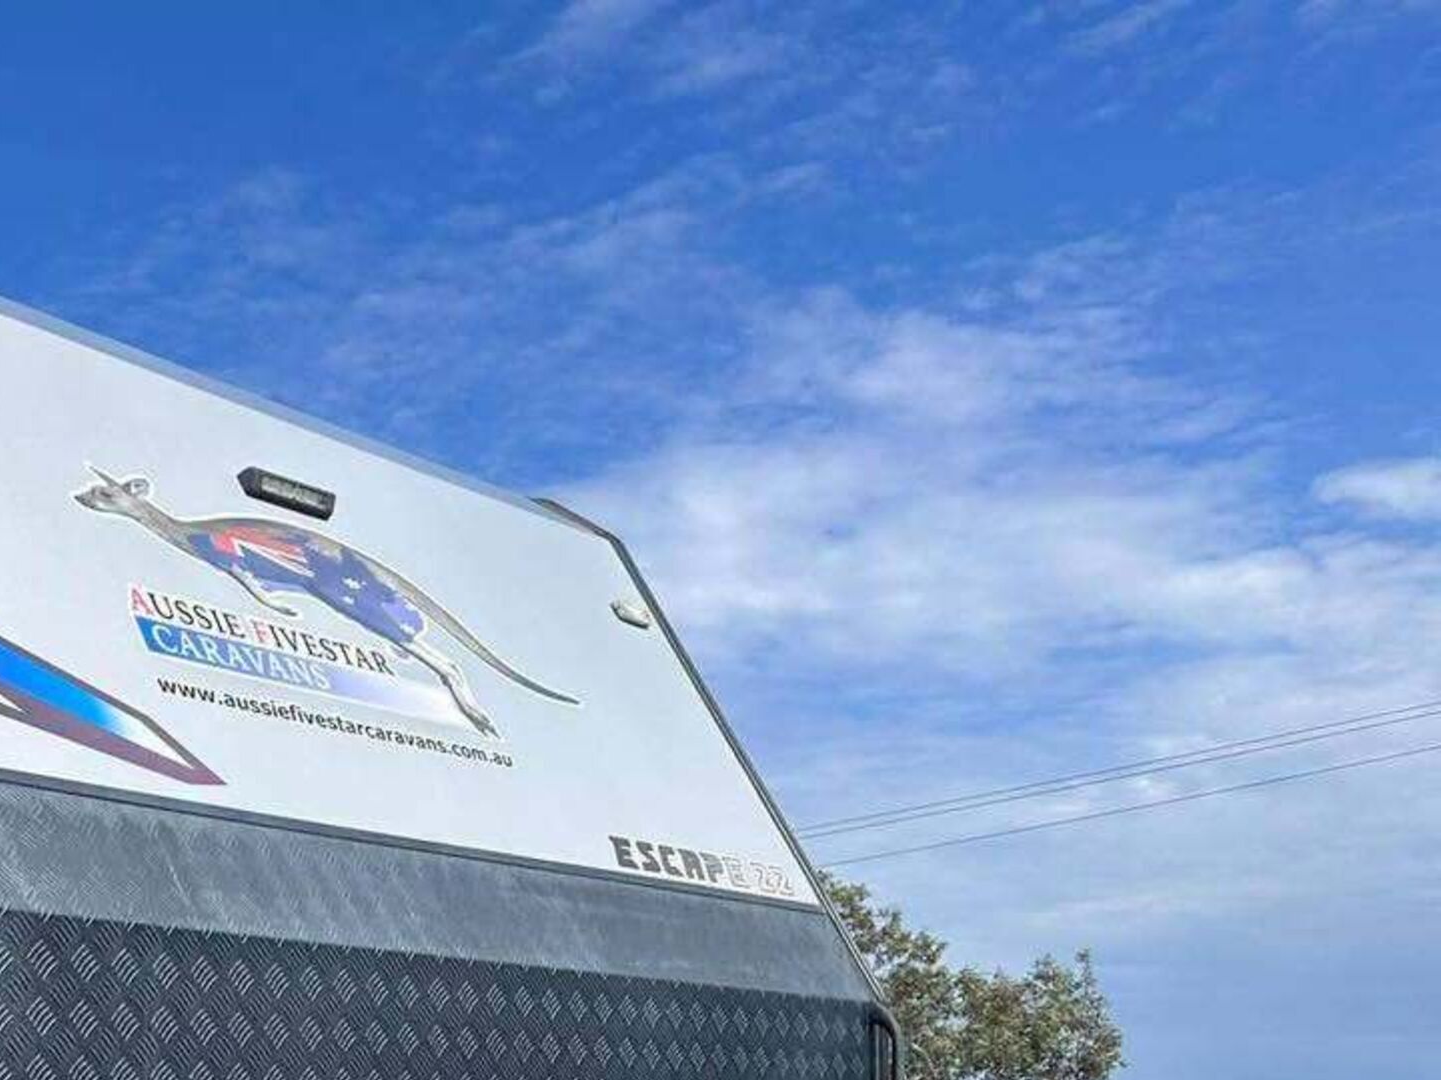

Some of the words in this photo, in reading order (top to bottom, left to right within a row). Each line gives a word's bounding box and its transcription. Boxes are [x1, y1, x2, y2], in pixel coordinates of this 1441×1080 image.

[130, 584, 246, 640] AUSSIE
[249, 617, 396, 676] FIVESTAR
[151, 623, 332, 691] CARAVANS
[156, 677, 513, 767] www.aussiefivestarcaravans.com.au
[609, 836, 750, 889] ESCAPE
